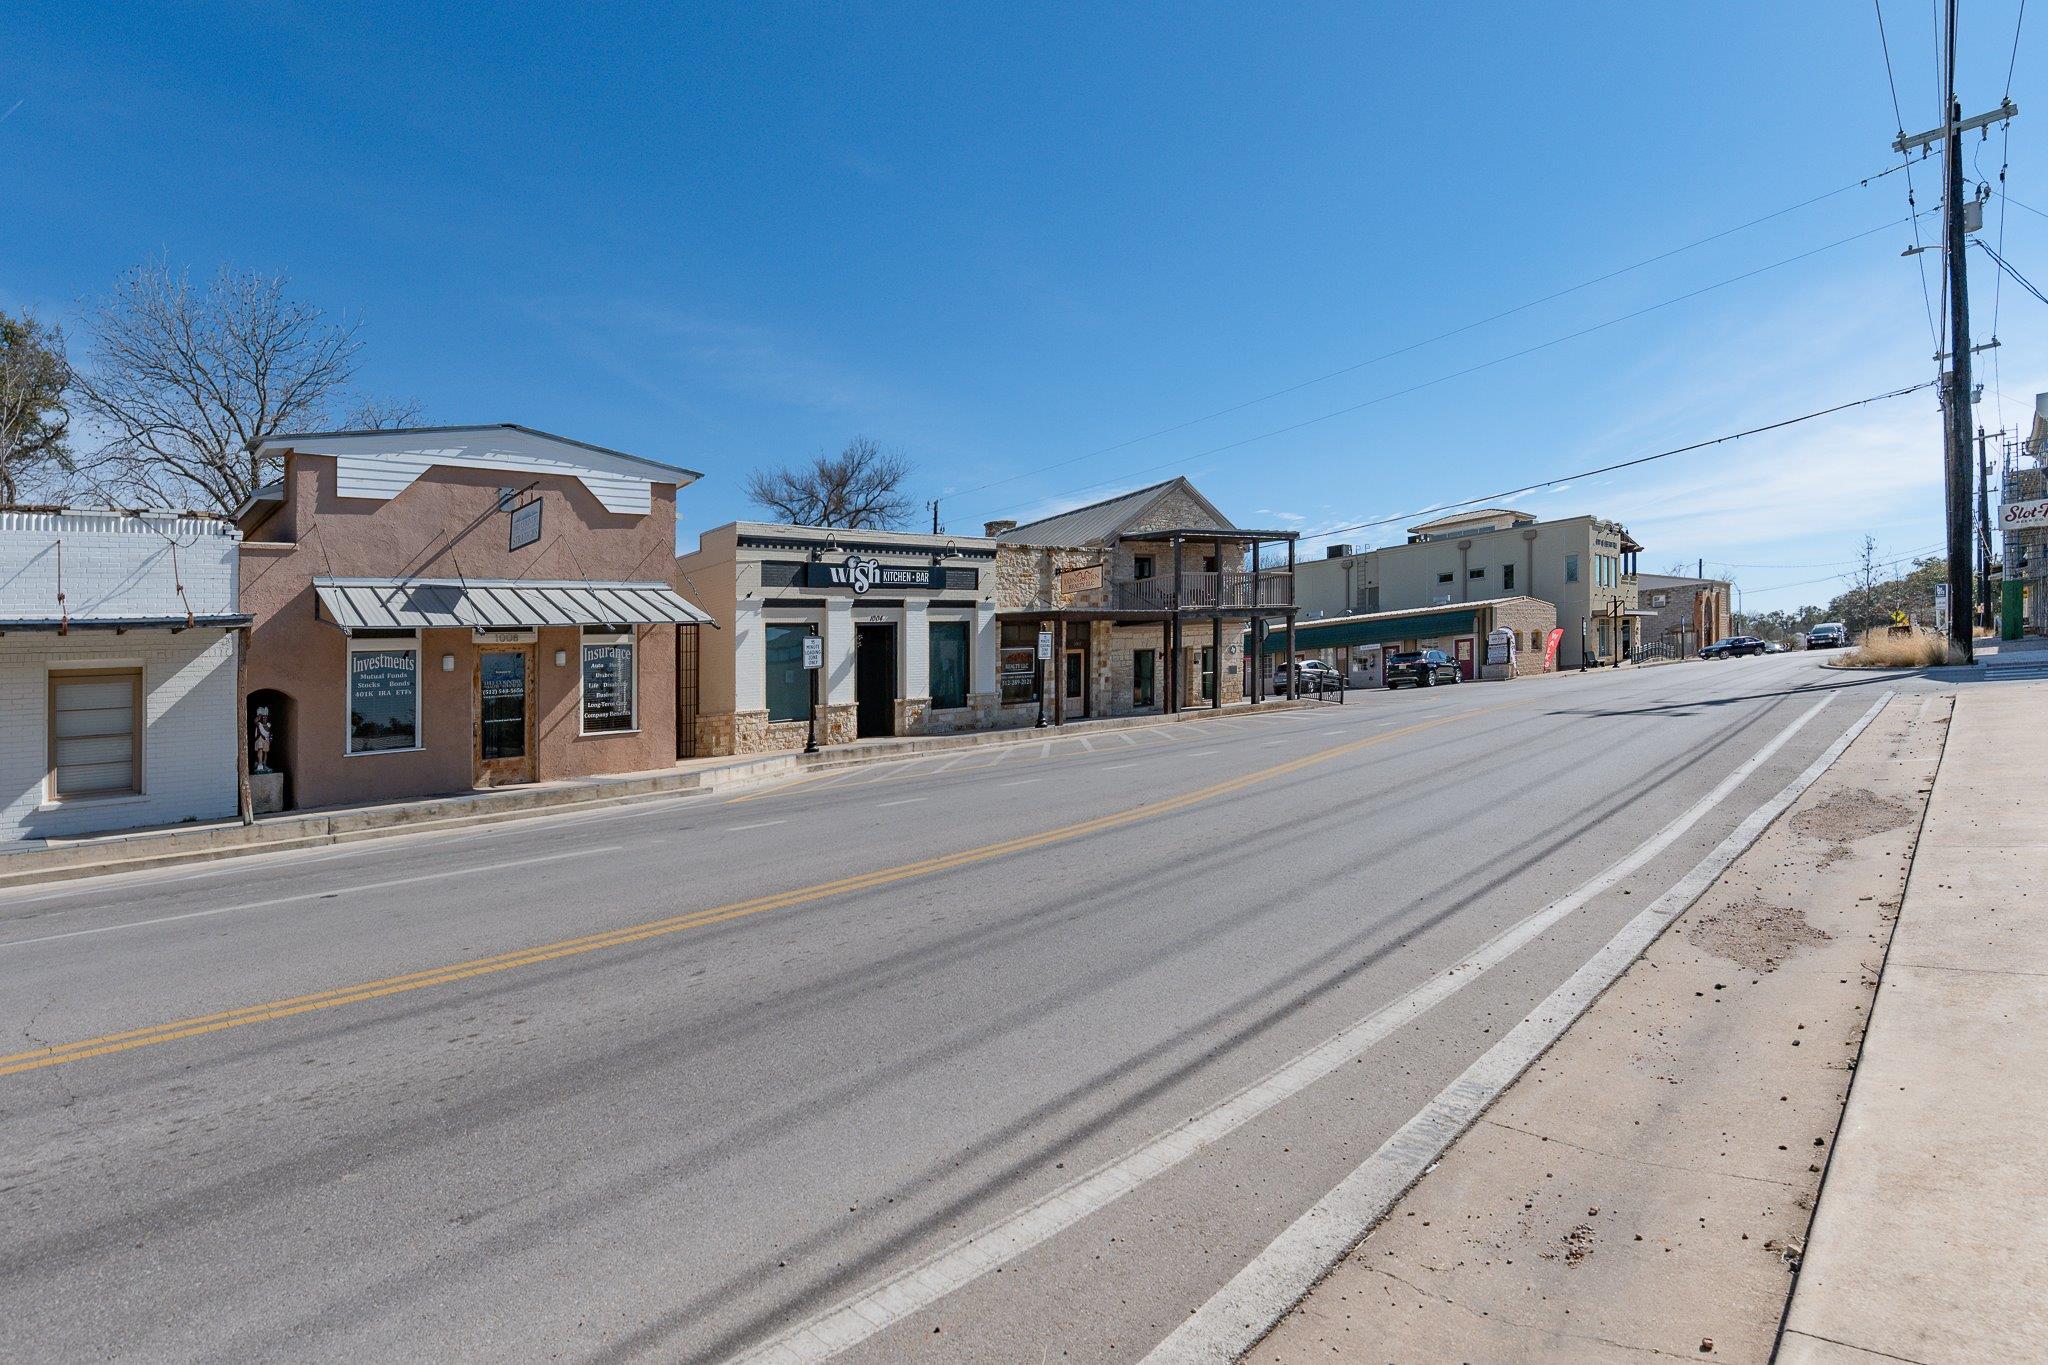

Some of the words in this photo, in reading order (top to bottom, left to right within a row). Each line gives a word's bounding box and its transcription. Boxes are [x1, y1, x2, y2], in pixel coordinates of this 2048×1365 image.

[883, 570, 911, 583] KITCHEN
[915, 571, 929, 583] BAR
[1069, 582, 1085, 590] REALTY
[495, 634, 519, 642] 1008
[584, 647, 631, 662] Insurance
[353, 653, 414, 673] Investments
[355, 690, 374, 698] 401K
